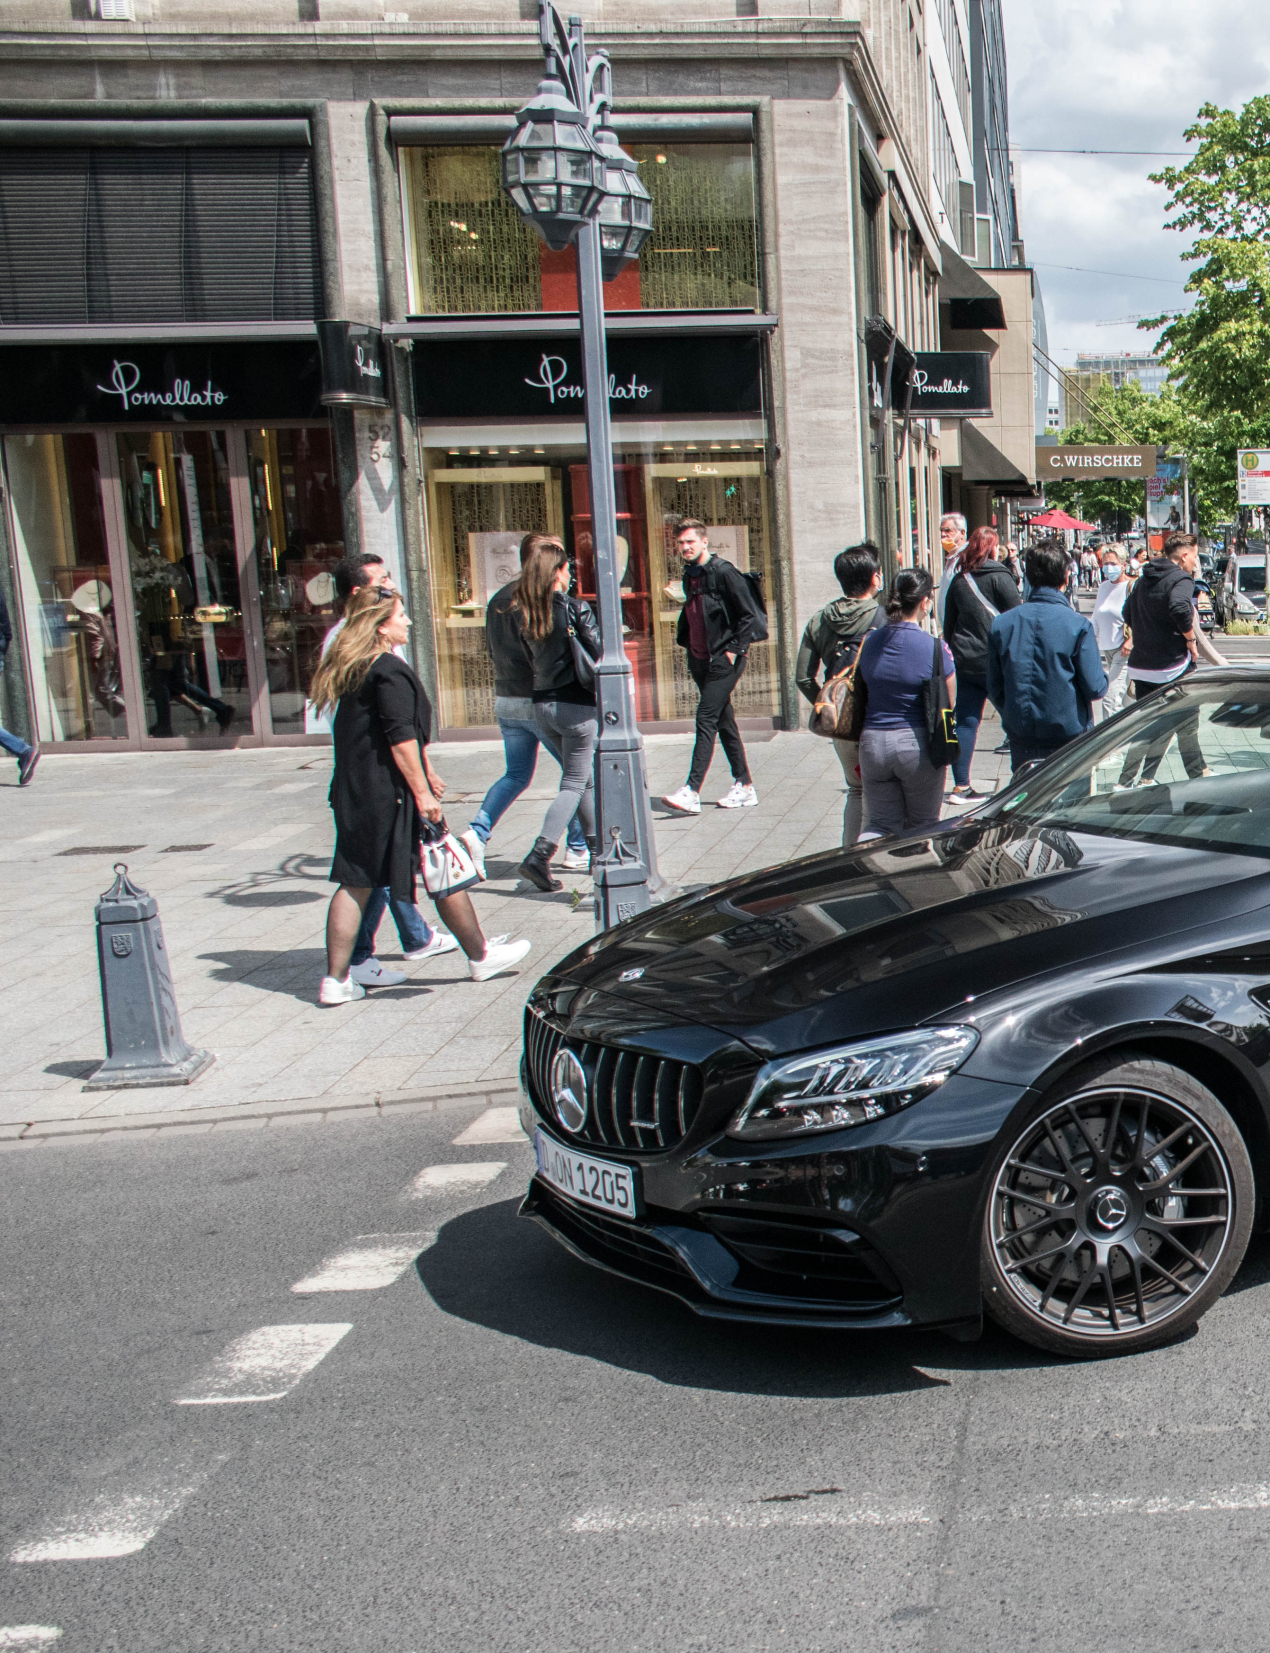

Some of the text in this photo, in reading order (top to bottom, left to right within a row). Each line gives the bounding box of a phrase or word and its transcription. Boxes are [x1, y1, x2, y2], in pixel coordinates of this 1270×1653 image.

[97, 359, 229, 410] Pomellato
[524, 353, 652, 403] Pomlato
[906, 369, 970, 396] Pomellato
[1050, 455, 1142, 468] C.WIRSCHKE
[555, 1150, 575, 1191] ON
[577, 1161, 629, 1209] 1205
